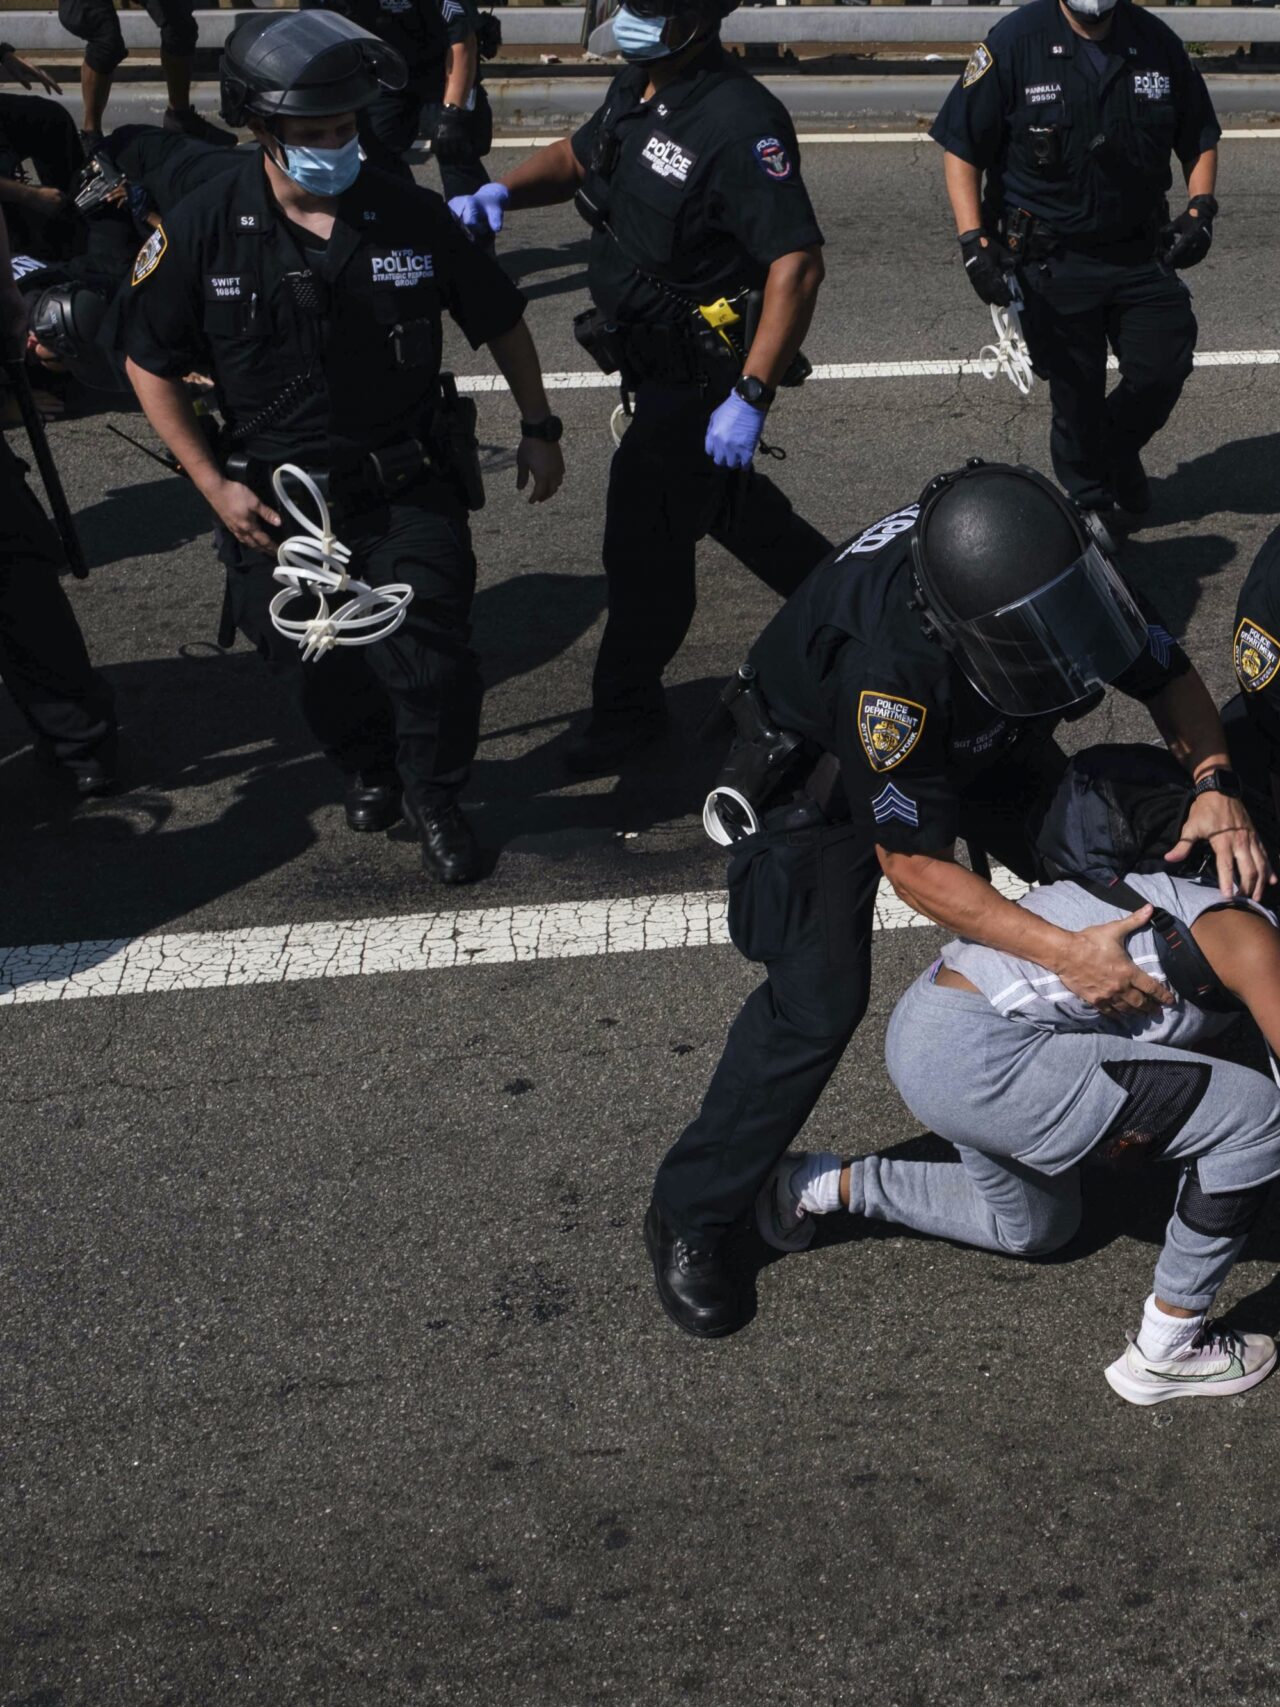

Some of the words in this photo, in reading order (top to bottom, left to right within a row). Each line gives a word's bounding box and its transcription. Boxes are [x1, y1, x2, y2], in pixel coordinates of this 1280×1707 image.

[1025, 84, 1061, 96] PANNULLA
[1134, 75, 1170, 89] POLICE
[646, 137, 692, 174] POLICE
[240, 215, 255, 226] S2
[371, 254, 433, 274] POLICE
[211, 277, 241, 287] SWIFT
[876, 698, 909, 715] POLICE
[864, 704, 919, 727] DEPARTMENT
[861, 722, 870, 744] CITY
[899, 731, 918, 753] YORK
[884, 752, 901, 767] NEW
